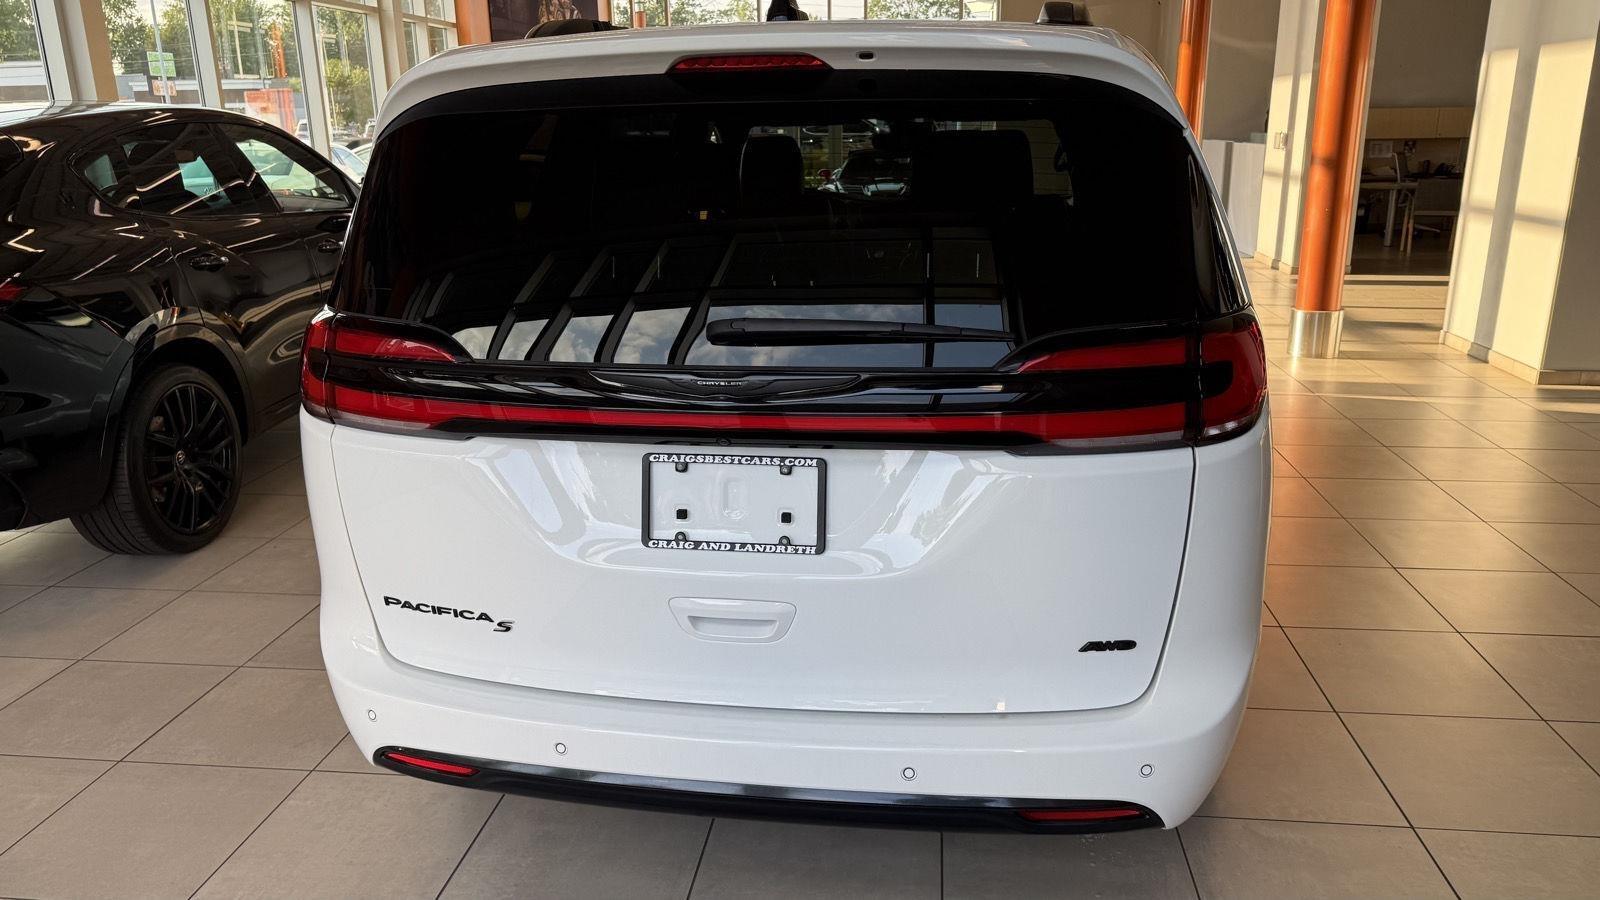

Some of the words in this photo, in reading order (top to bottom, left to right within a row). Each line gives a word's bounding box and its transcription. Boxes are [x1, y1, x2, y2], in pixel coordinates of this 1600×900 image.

[649, 453, 818, 467] CRAIGSBESTCARS.COM
[648, 540, 695, 550] CRAIG
[698, 542, 731, 551] AND
[734, 543, 817, 555] LANDRETH
[383, 595, 495, 623] PACIFICA
[493, 620, 515, 632] S
[1078, 639, 1138, 652] AWD
